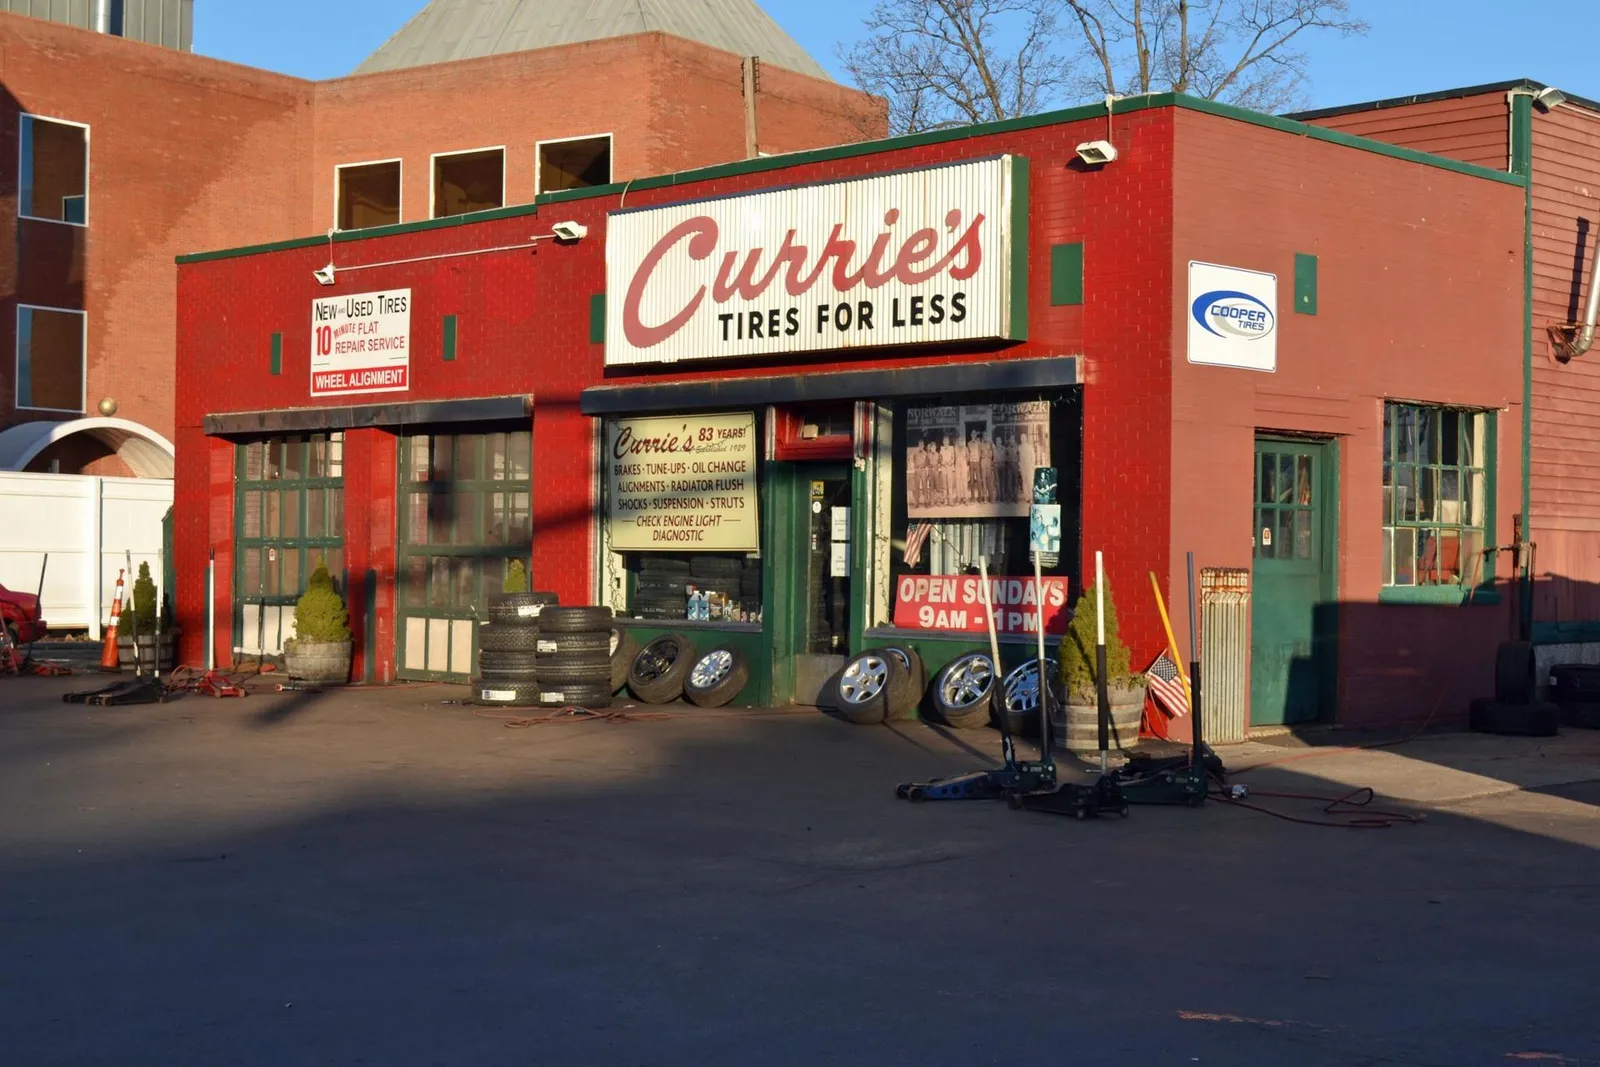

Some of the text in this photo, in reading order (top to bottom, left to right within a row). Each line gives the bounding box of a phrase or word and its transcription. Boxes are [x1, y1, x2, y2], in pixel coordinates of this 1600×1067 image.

[622, 207, 986, 349] Currie's
[315, 302, 338, 321] NEW
[346, 298, 374, 318] USED
[377, 295, 407, 315] TIRES
[718, 292, 967, 342] TIRES FOR LESS
[1210, 304, 1266, 322] COOPER
[1238, 319, 1265, 331] TIRES
[316, 321, 379, 356] 10 MINUTE FLAT
[335, 336, 405, 355] REPAIR SERVICE
[315, 369, 404, 389] WHEEL ALIGNMENT
[613, 423, 693, 459] Currie's
[698, 427, 746, 442] 83 YEARS!
[729, 443, 747, 452] 1929
[614, 460, 746, 476] BRAKES TUNE-UPS OIL CHANGE
[618, 479, 744, 493] ALIGNMENTS RADIATOR FLUSH
[618, 496, 745, 511] SHOCKS SUSPENSION STRUTS
[636, 514, 722, 527] CHECK ENGINE LIGHT
[652, 529, 704, 541] DIAGNOSTIC
[900, 577, 958, 603] OPEN
[918, 605, 967, 629] 9AM
